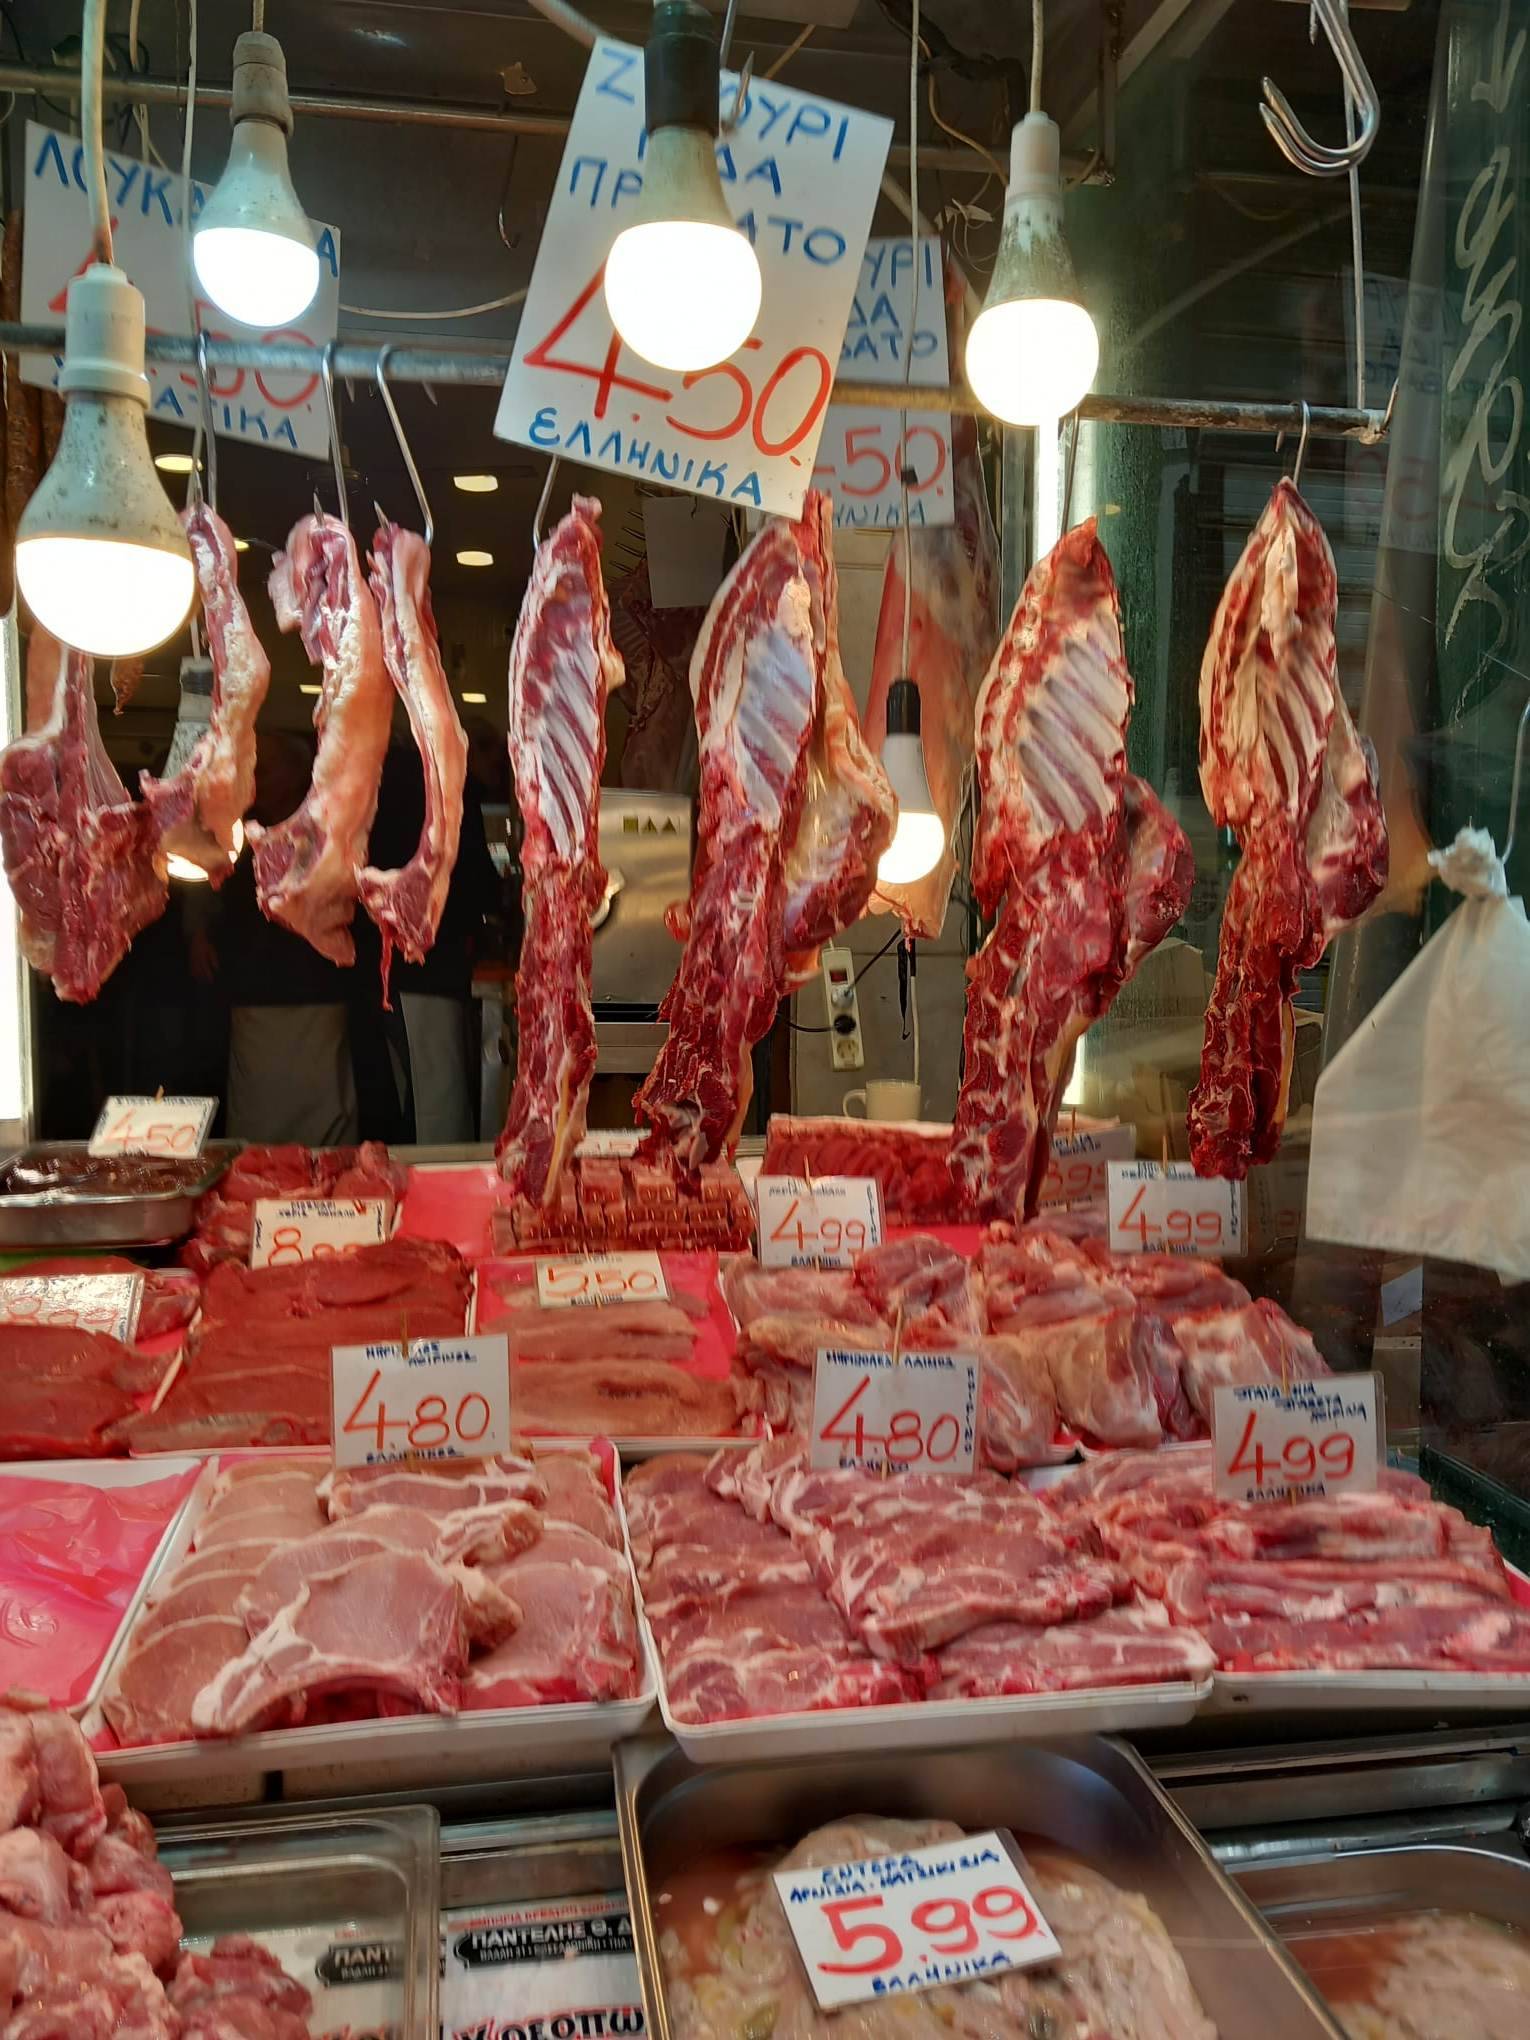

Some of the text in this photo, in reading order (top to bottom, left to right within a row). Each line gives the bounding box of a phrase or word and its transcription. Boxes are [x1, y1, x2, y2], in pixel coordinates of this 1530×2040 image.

[594, 46, 850, 162] ΖΟΥΡΙ
[529, 406, 762, 507] ΕΛΛΗΝΙΚΑ
[472, 1920, 586, 1949] ΠΑΝΤΕΛΗΣ
[618, 1917, 632, 1936] Δ
[872, 1950, 1012, 1996] ΕΛΛΗΝΙΚΑ
